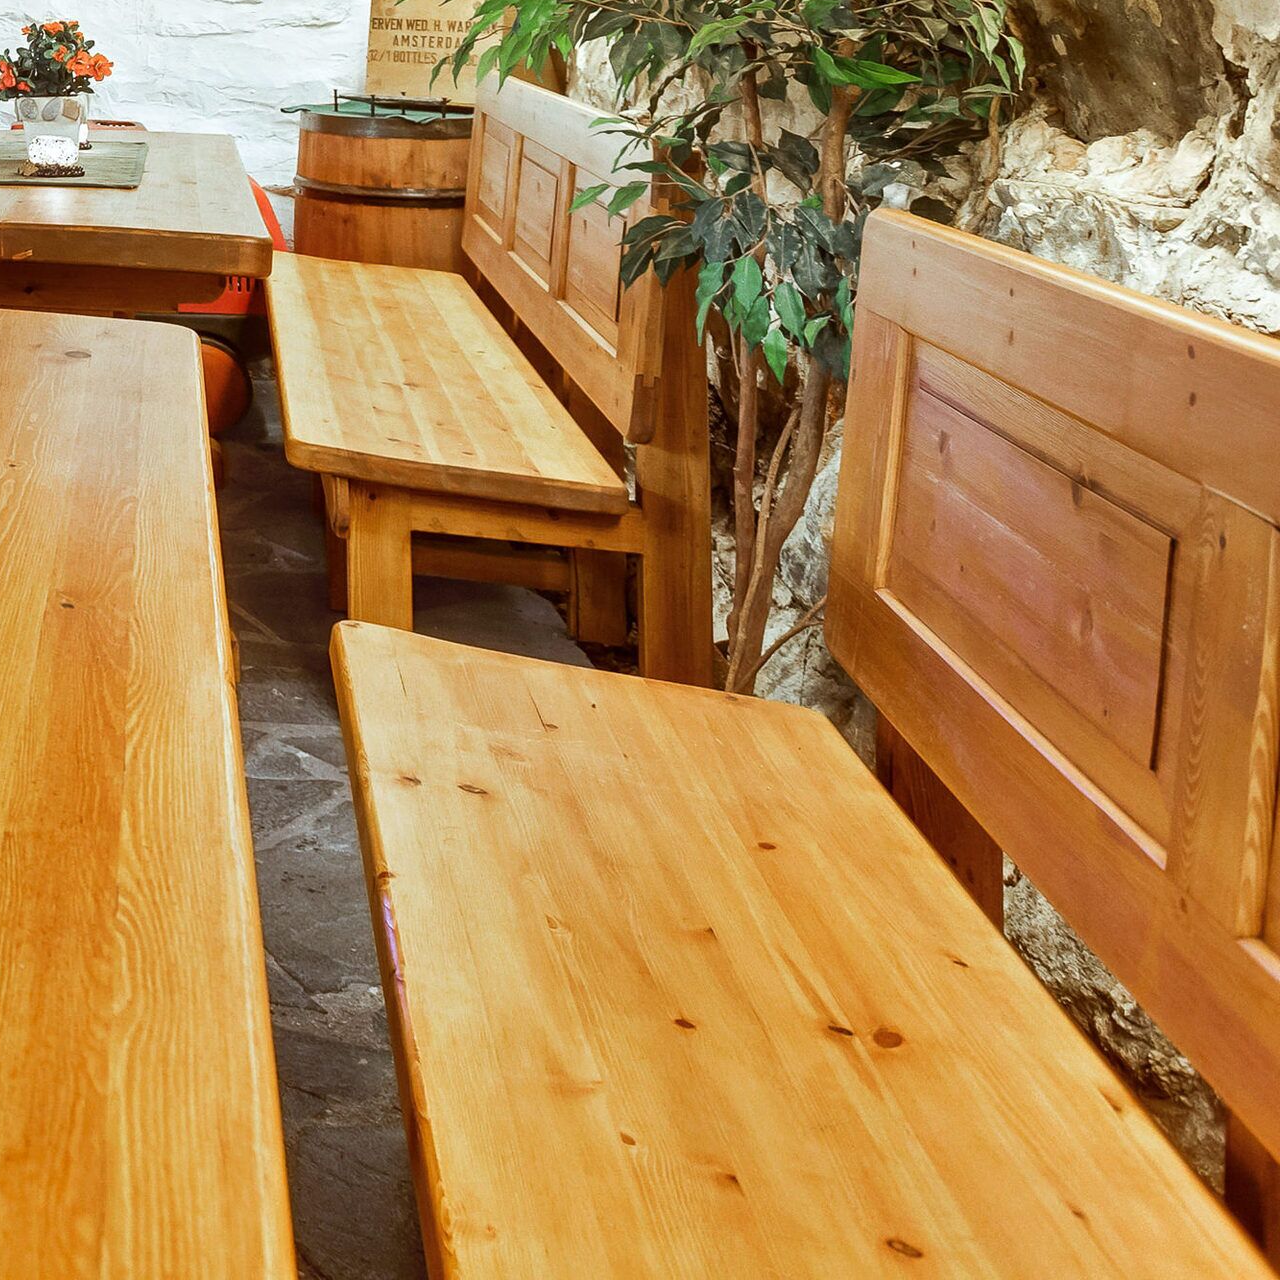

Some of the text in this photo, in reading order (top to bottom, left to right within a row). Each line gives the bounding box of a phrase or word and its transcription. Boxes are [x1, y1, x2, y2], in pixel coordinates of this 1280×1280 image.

[372, 17, 404, 30] ERVEN
[392, 35, 463, 49] AMSTERDA
[393, 50, 437, 64] BOTTLES
